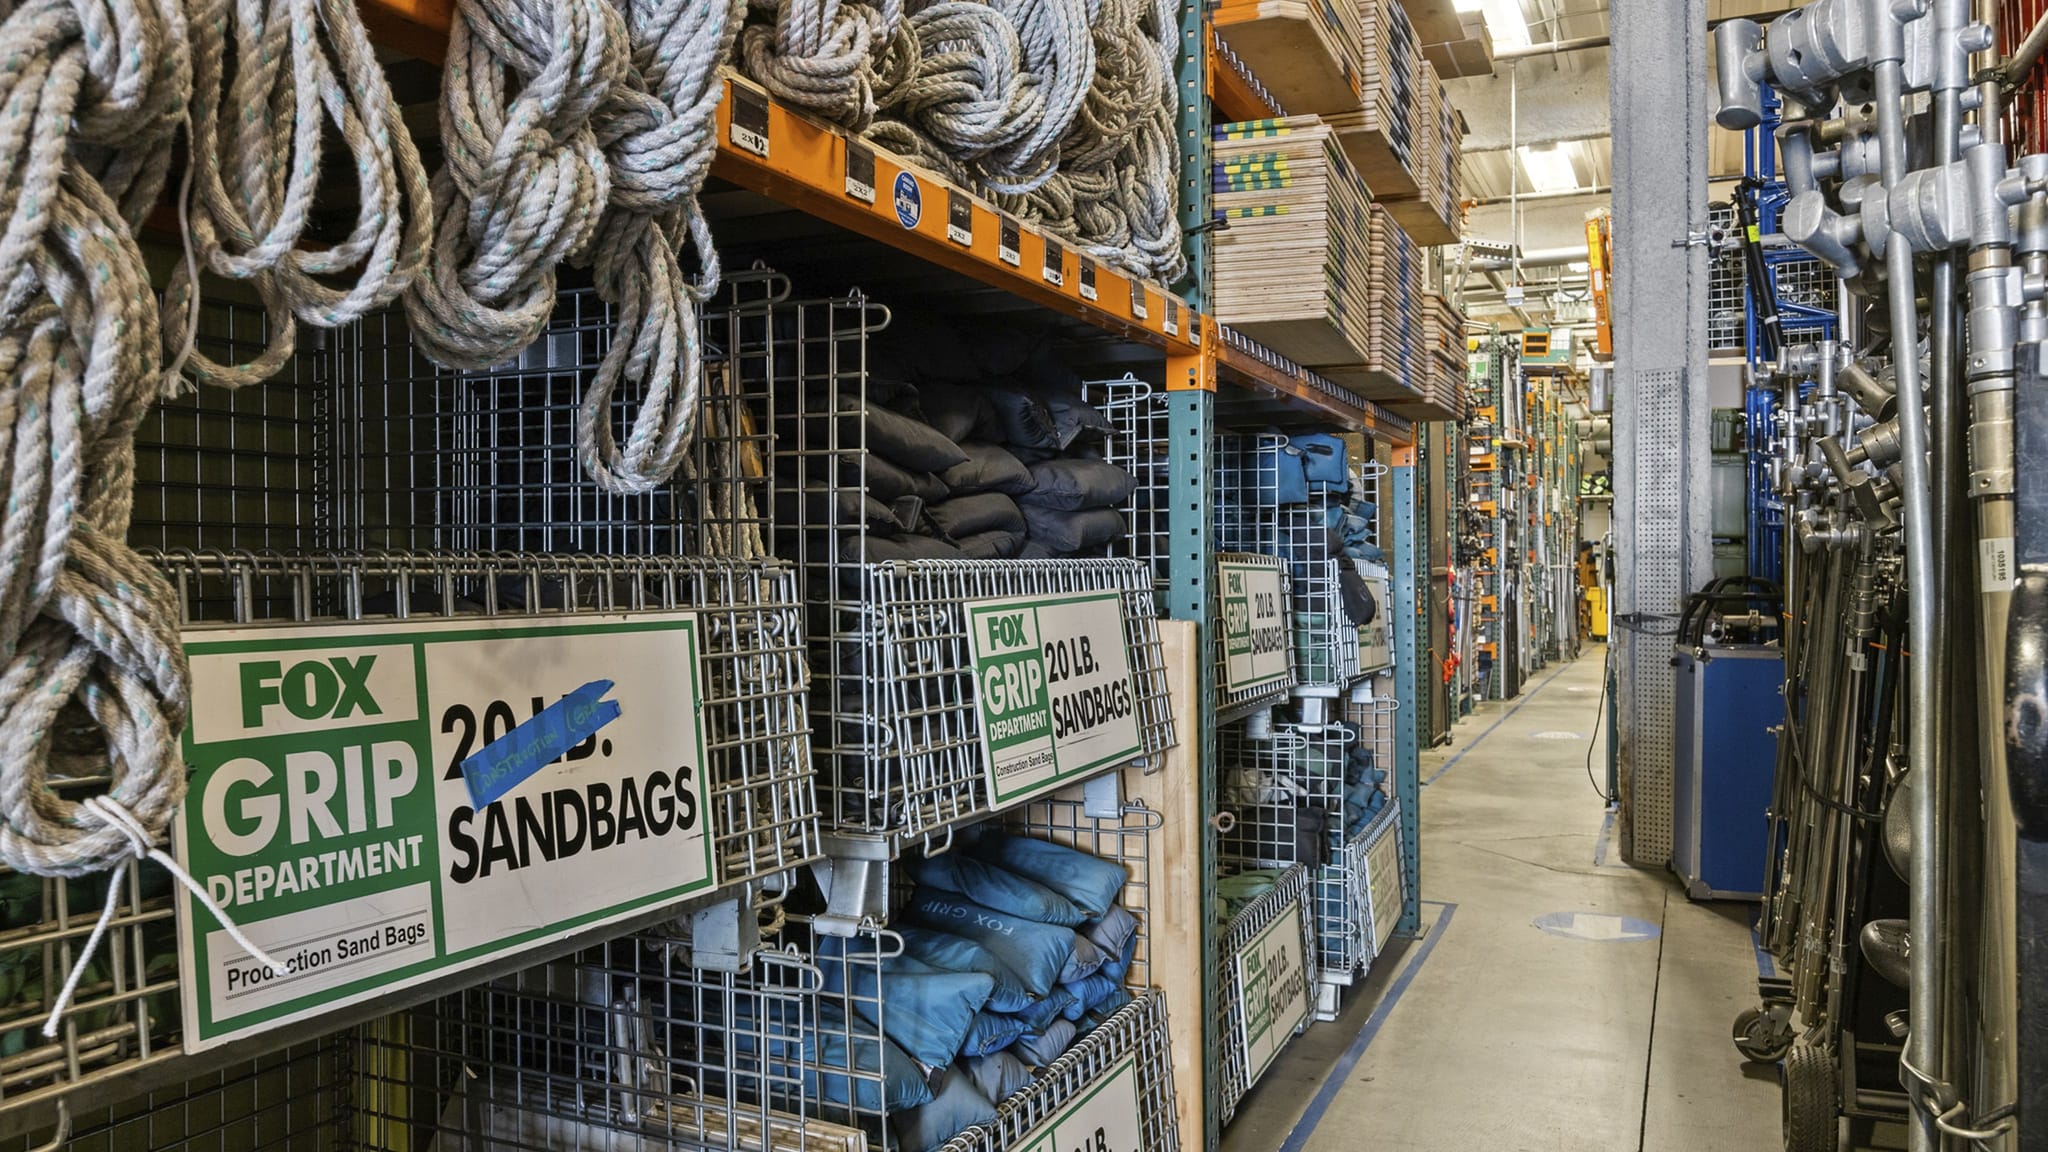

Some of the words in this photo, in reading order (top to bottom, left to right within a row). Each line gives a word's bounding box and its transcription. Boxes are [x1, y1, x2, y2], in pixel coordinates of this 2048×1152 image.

[1228, 572, 1242, 594] FOX
[1227, 603, 1247, 634] GRIP
[1255, 593, 1264, 619] 20
[987, 613, 1028, 651] FOX
[1252, 626, 1283, 656] SANDBAGS
[1045, 640, 1070, 684] 20
[1070, 635, 1099, 677] LB.
[239, 654, 383, 729] FOX
[984, 659, 1042, 715] GRIP
[990, 709, 1047, 742] DEPARTMENT
[1053, 678, 1131, 739] SANDBAGS
[996, 760, 1029, 777] Construction
[1029, 756, 1041, 768] Sand
[1041, 752, 1054, 764] Bags
[202, 740, 418, 857] GRIP
[448, 765, 697, 884] SANDBAGS
[207, 835, 423, 911] DEPARTMENT
[921, 901, 967, 919] GRIP
[973, 913, 1014, 936] FOX
[228, 949, 331, 991] Prodction
[337, 930, 380, 960] Sand
[385, 922, 426, 947] Bags
[1246, 947, 1261, 980] FOX
[1268, 954, 1277, 987] 20
[1246, 976, 1267, 1024] GRIP
[1271, 965, 1303, 1024] SHOTBAGS
